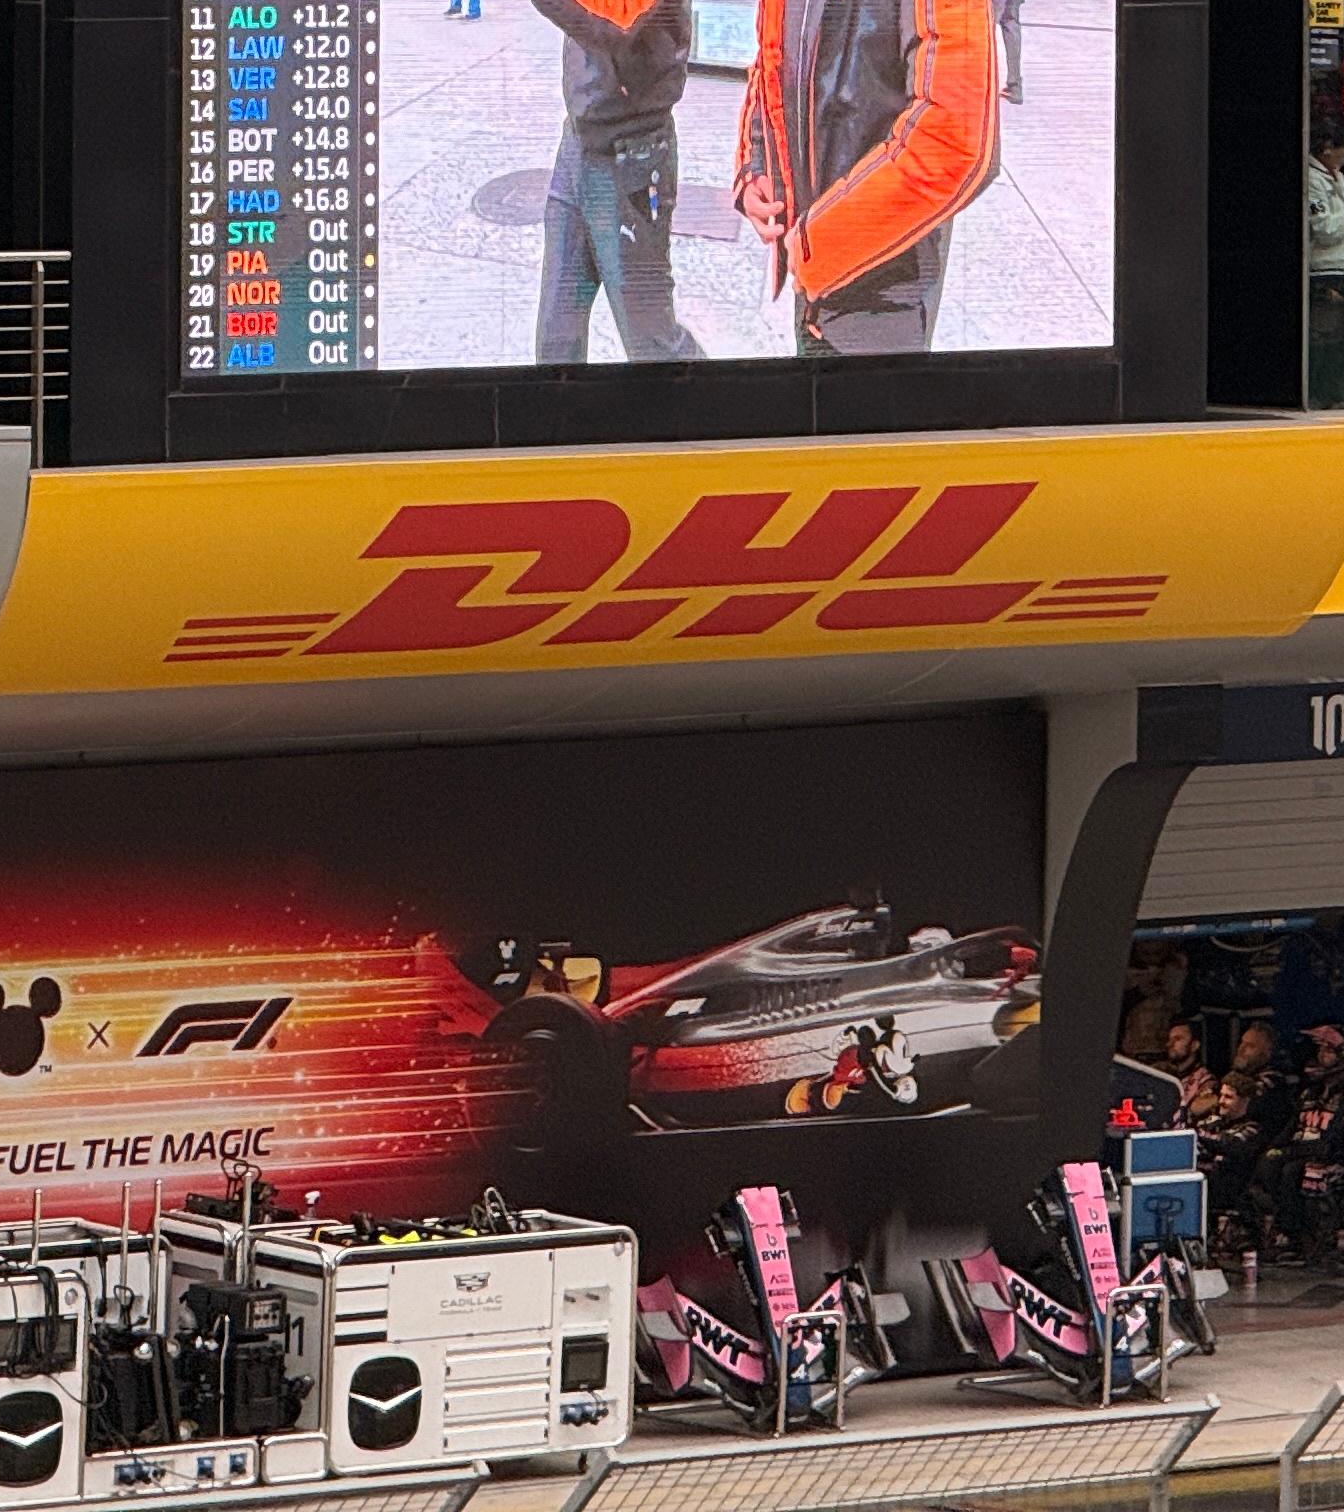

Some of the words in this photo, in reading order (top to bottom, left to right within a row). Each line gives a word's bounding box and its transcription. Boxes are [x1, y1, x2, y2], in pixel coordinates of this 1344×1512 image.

[190, 7, 216, 30] 11
[227, 6, 278, 30] ALO
[293, 4, 350, 28] +11.2
[190, 38, 215, 61] 12
[228, 35, 284, 60] LAW
[292, 35, 350, 59] +12.0
[190, 69, 215, 91] 13
[227, 66, 277, 92] VER
[292, 65, 350, 89] +12.8
[190, 99, 215, 122] 14
[228, 97, 268, 122] SAI
[292, 95, 350, 120] +14.0
[190, 130, 215, 154] 15
[228, 127, 278, 153] BOT
[291, 126, 349, 151] +14.8
[190, 161, 215, 184] 16
[228, 158, 275, 183] PER
[291, 157, 350, 181] +15.4
[189, 191, 215, 215] 17
[227, 189, 280, 214] HAD
[292, 187, 349, 212] +16.8
[189, 222, 215, 246] 18
[228, 221, 276, 244] STR
[308, 218, 349, 242] Out
[189, 254, 215, 277] 19
[226, 250, 269, 276] PIA
[308, 248, 349, 273] Out
[188, 284, 214, 307] 20
[226, 280, 281, 306] NOR
[308, 279, 349, 303] Out
[189, 315, 214, 339] 21
[226, 312, 279, 337] BOR
[308, 310, 349, 334] Out
[189, 346, 215, 369] 22
[227, 342, 275, 368] ALB
[308, 340, 349, 365] Out
[299, 482, 1039, 656] DHL
[78, 1135, 153, 1170] THE
[159, 1127, 276, 1165] MAGIC
[440, 1294, 503, 1308] CADILLAC
